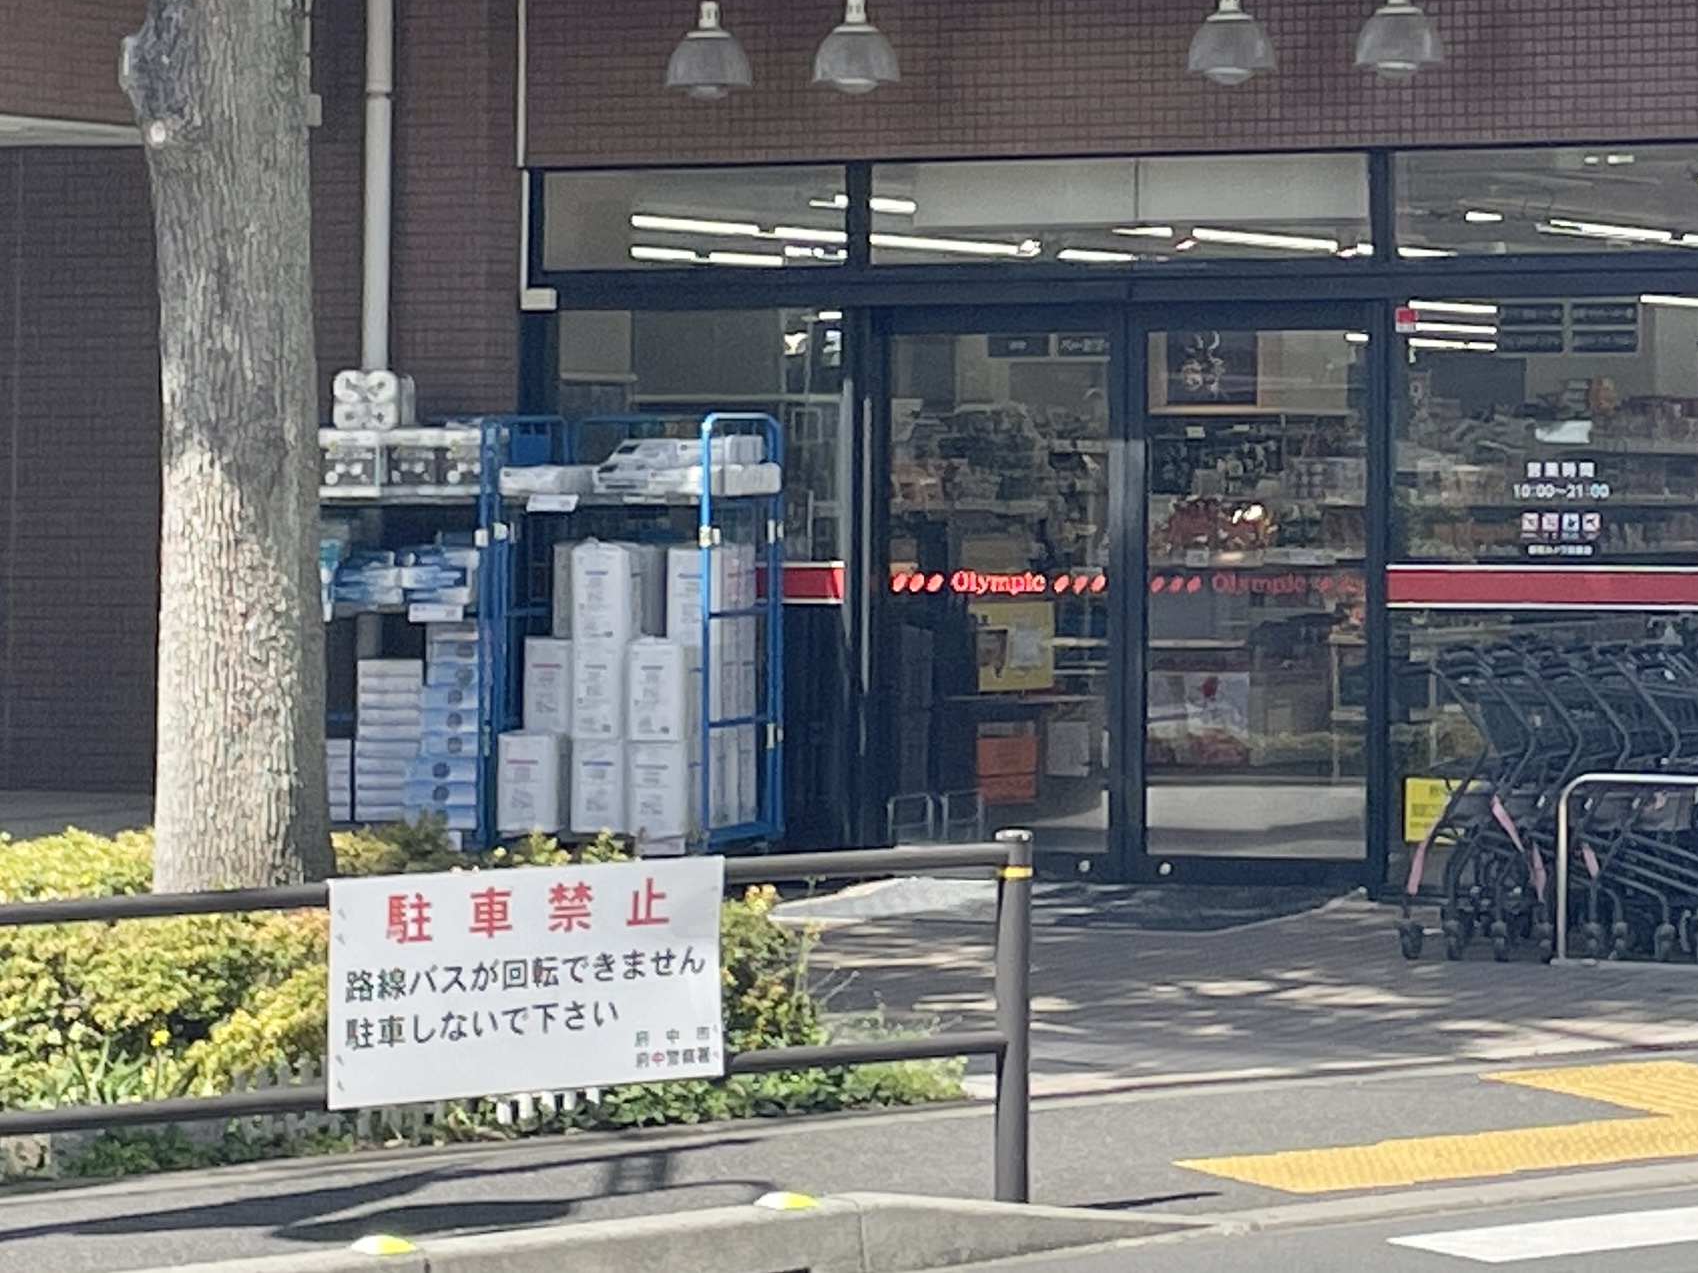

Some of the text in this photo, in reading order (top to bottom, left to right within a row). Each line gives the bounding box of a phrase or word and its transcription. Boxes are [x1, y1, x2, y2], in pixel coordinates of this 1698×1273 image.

[950, 570, 1046, 596] Olympic
[385, 877, 670, 944] 駐車禁止
[344, 945, 706, 1004] 路線バスが回転できません
[344, 1000, 620, 1051] 駐車しないで下さい
